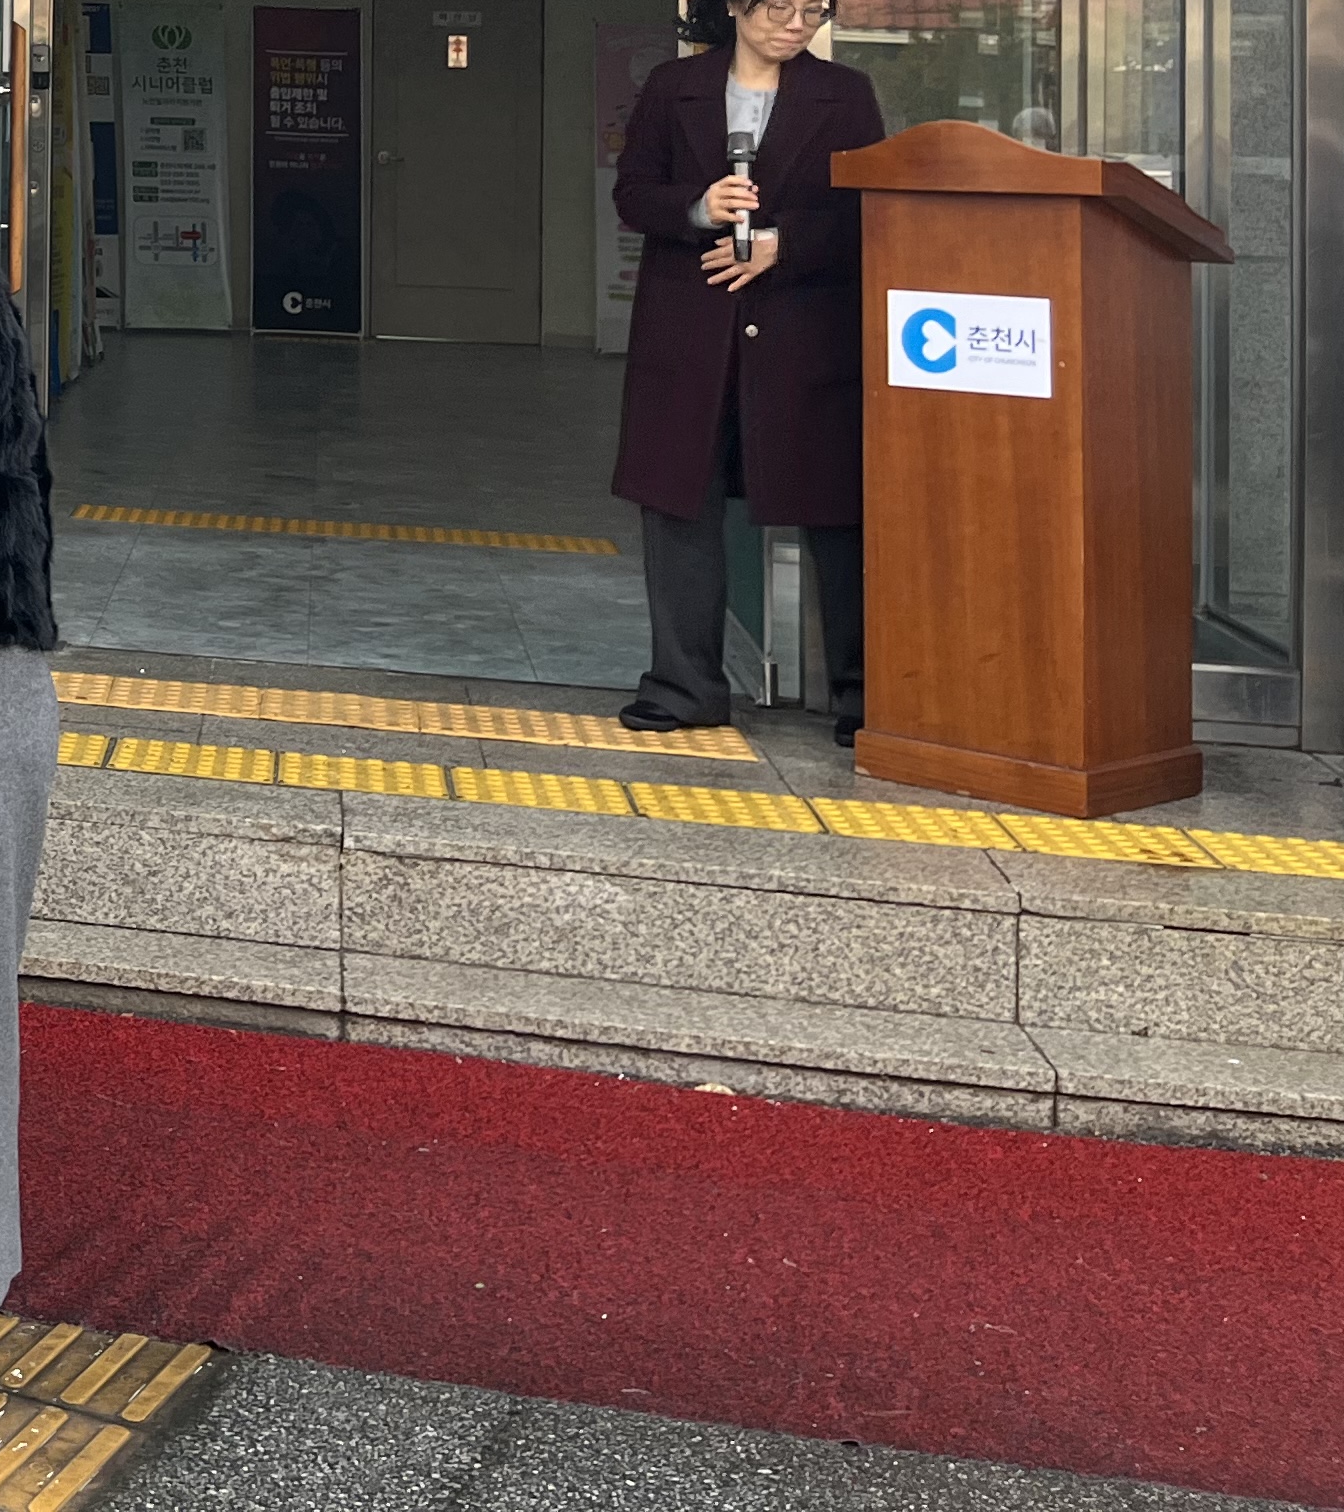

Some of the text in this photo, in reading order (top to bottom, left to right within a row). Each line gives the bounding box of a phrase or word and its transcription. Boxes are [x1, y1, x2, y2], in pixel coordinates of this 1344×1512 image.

[156, 57, 188, 74] 춘천
[132, 75, 213, 95] 시니어클럽
[294, 101, 317, 115] 조치
[283, 116, 295, 128] 수
[967, 325, 1036, 354] 춘천시
